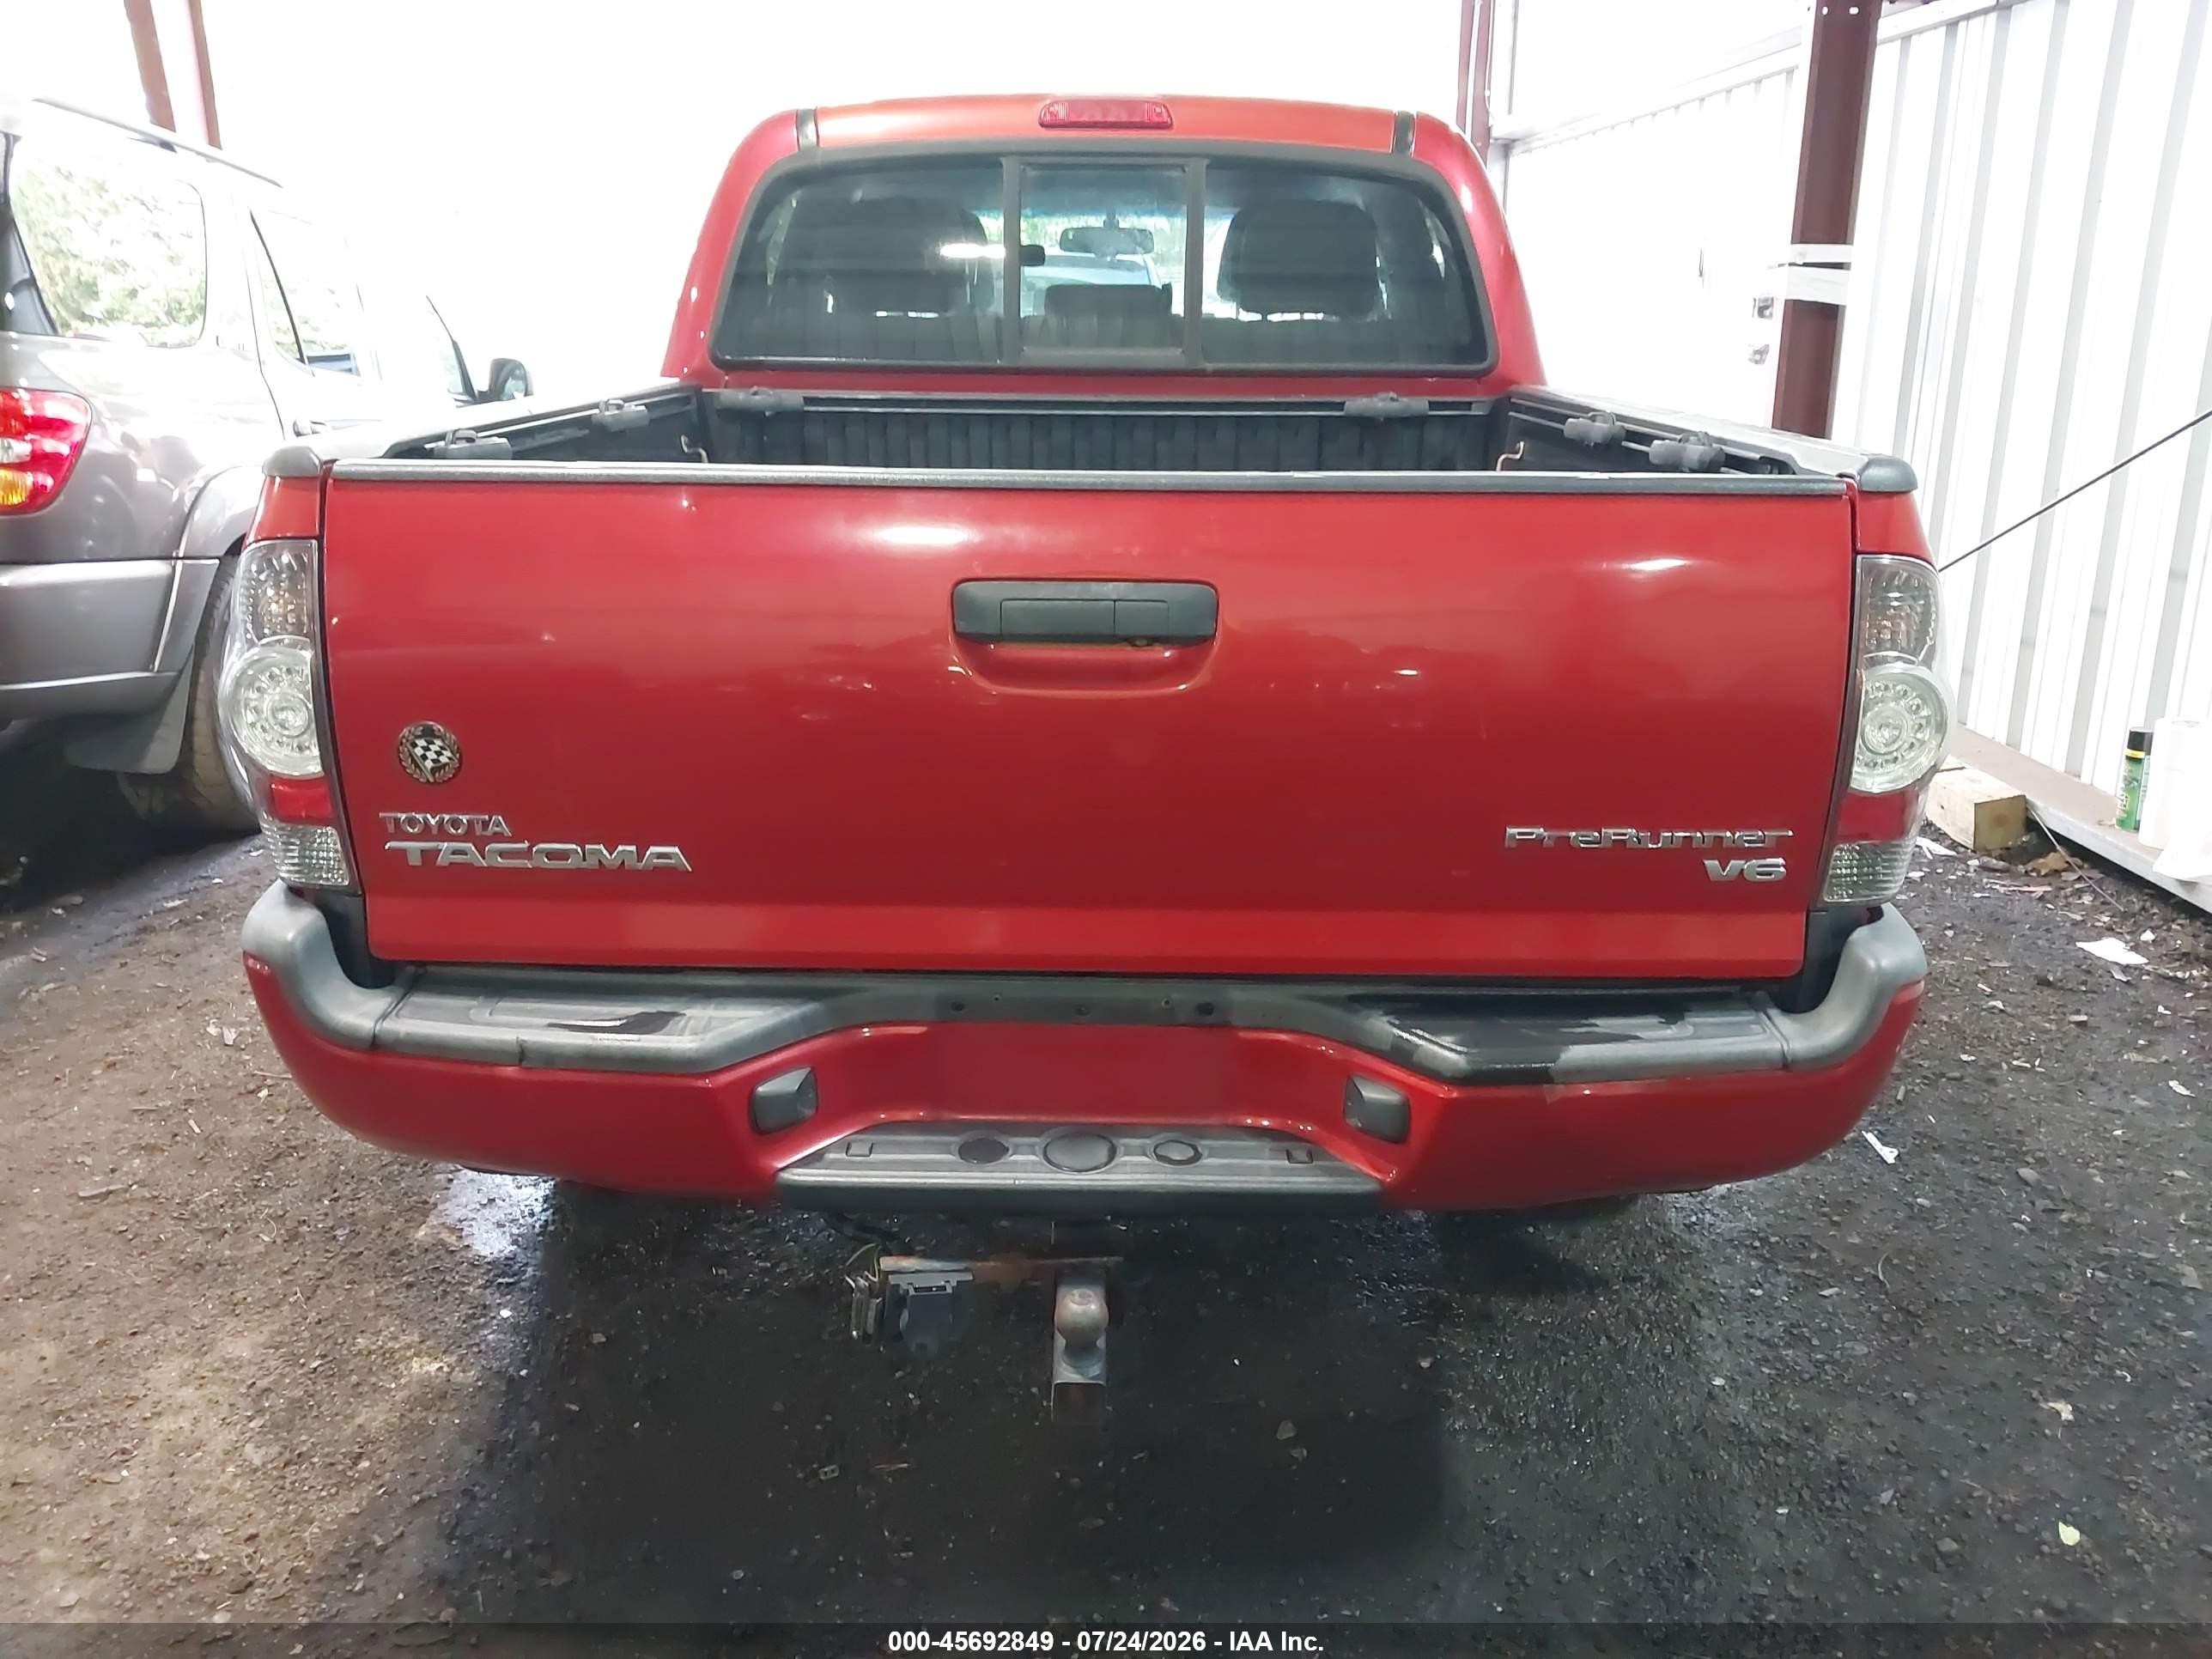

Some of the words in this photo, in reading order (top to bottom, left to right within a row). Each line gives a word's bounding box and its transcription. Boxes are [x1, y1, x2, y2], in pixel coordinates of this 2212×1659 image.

[379, 811, 513, 836] TOYOTA
[1505, 825, 1794, 848] PreRunner
[385, 839, 692, 872] TACOMA
[1702, 857, 1787, 882] V6
